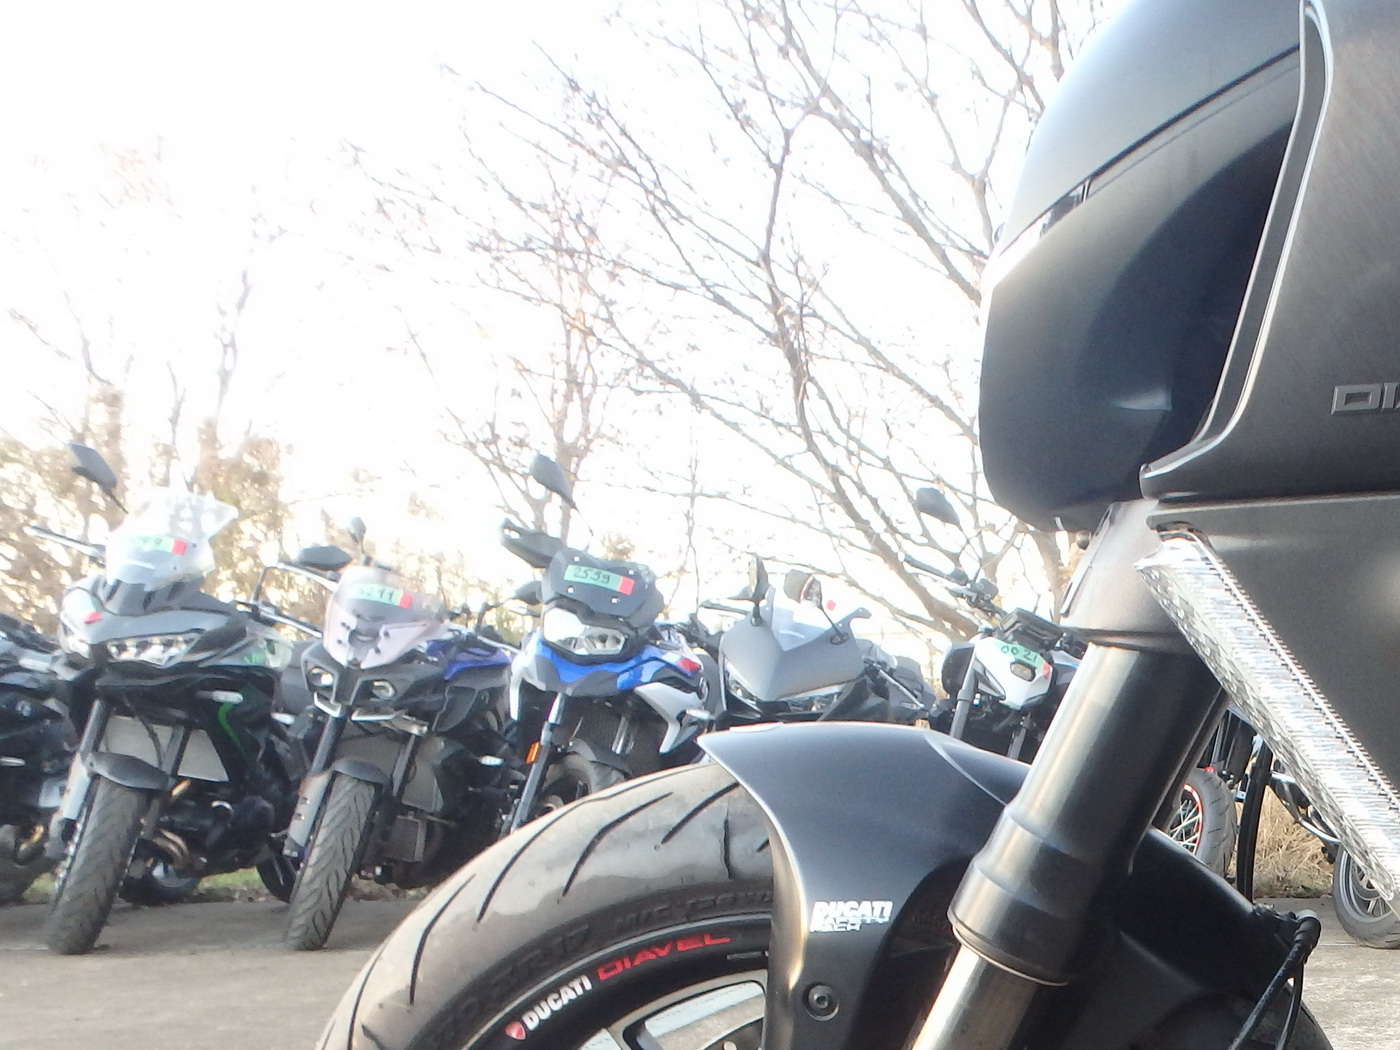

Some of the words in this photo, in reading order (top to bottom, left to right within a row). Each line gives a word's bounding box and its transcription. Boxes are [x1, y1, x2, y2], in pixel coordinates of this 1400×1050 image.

[811, 900, 894, 920] DUCATI
[521, 974, 593, 1031] DUCATI
[597, 931, 732, 982] DIAVEL
